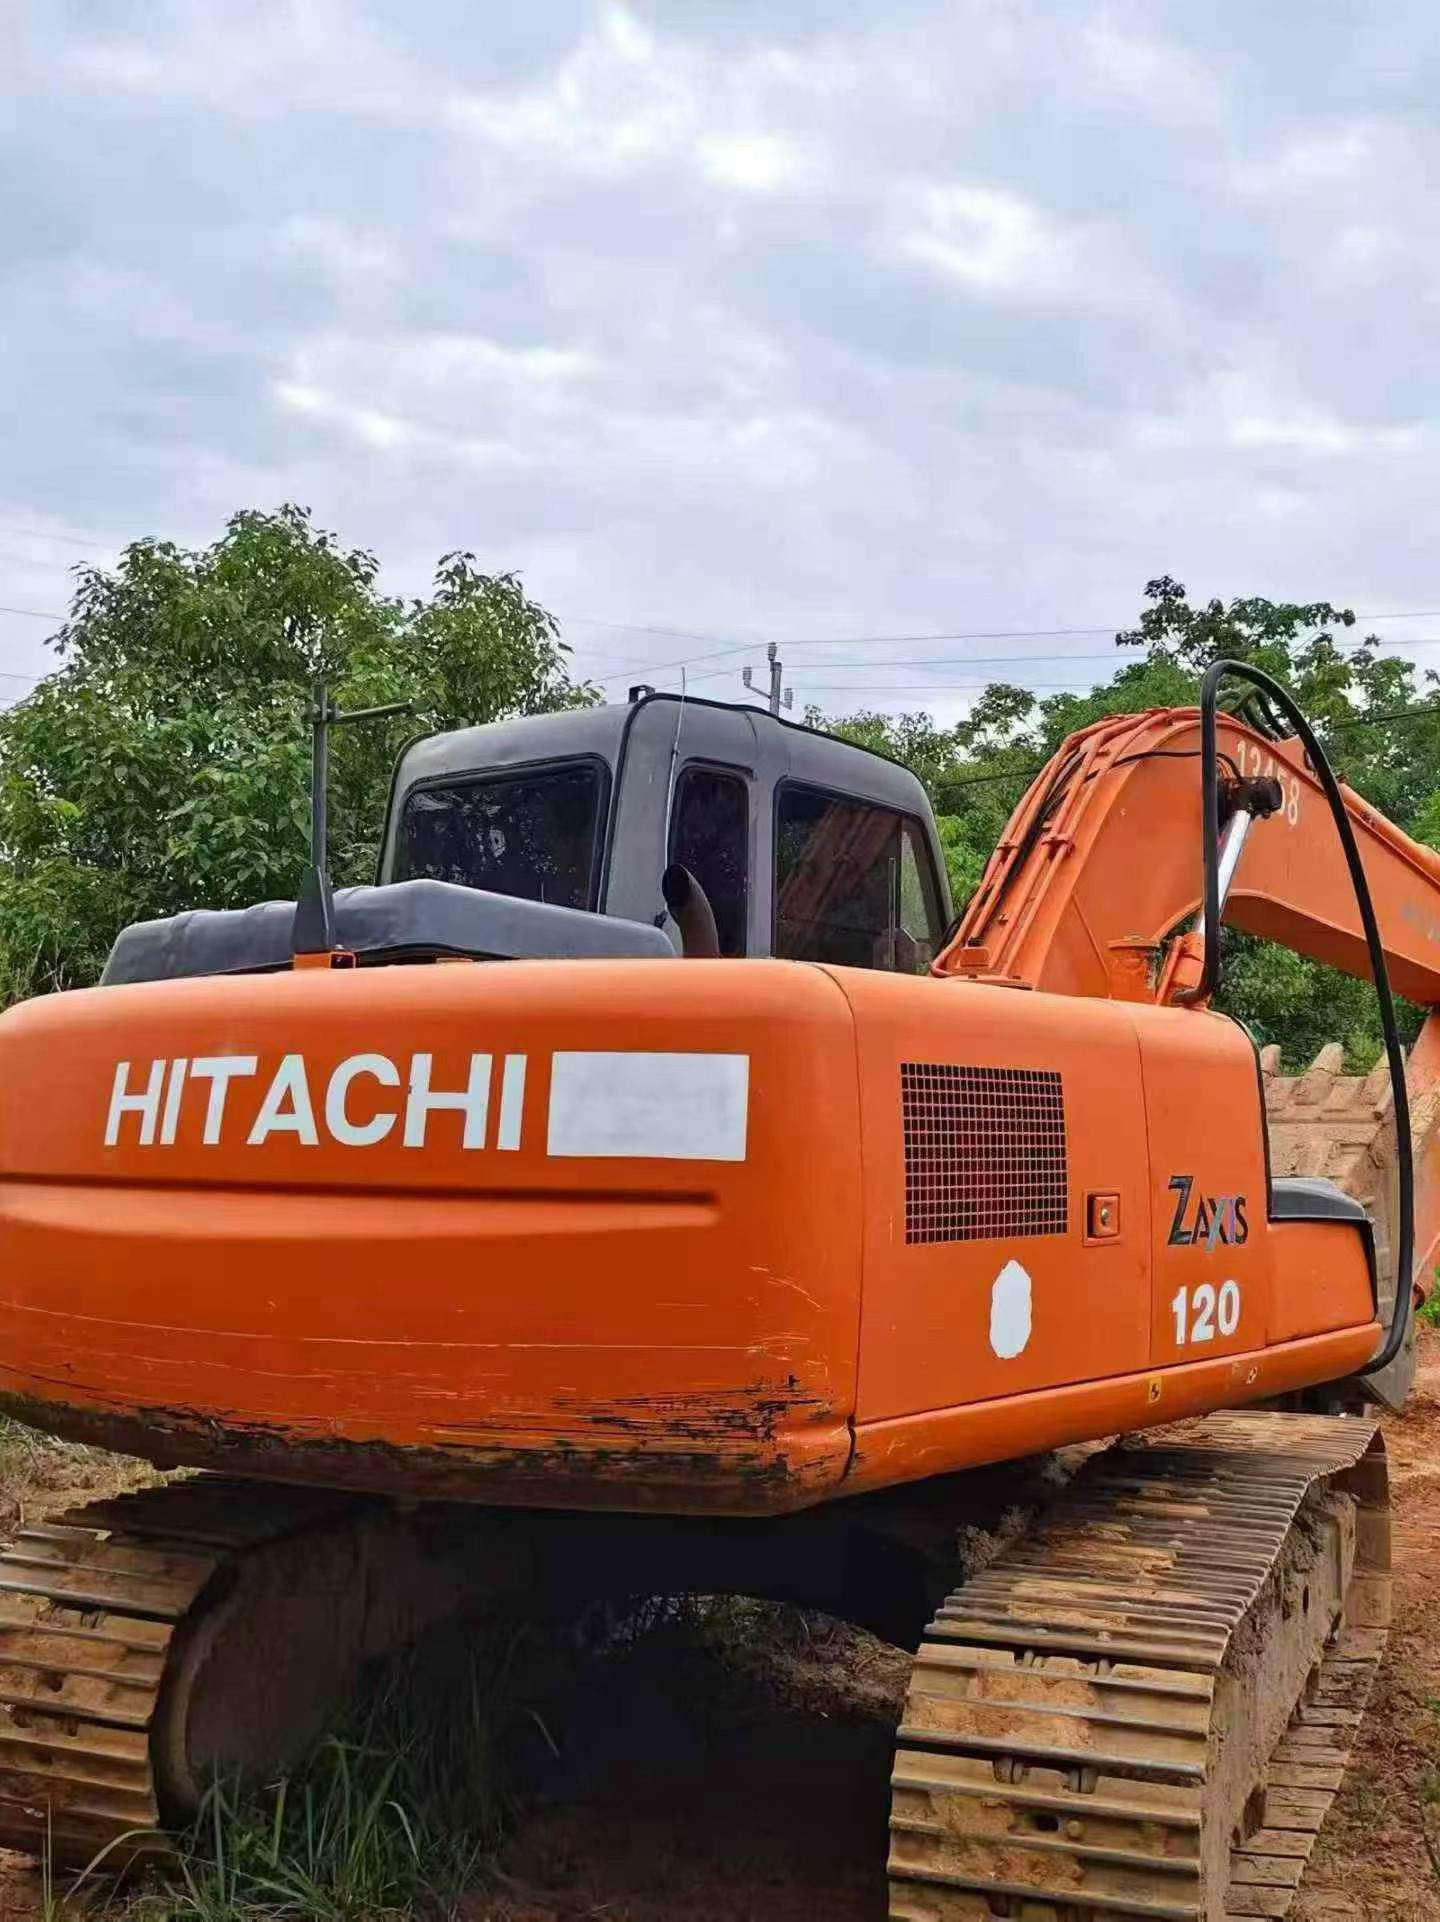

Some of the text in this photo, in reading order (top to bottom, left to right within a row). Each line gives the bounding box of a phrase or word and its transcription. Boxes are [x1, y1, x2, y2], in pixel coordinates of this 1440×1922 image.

[104, 1052, 527, 1151] HITACHI
[1167, 1175, 1248, 1251] ZAXIS
[1171, 1279, 1241, 1345] 120
